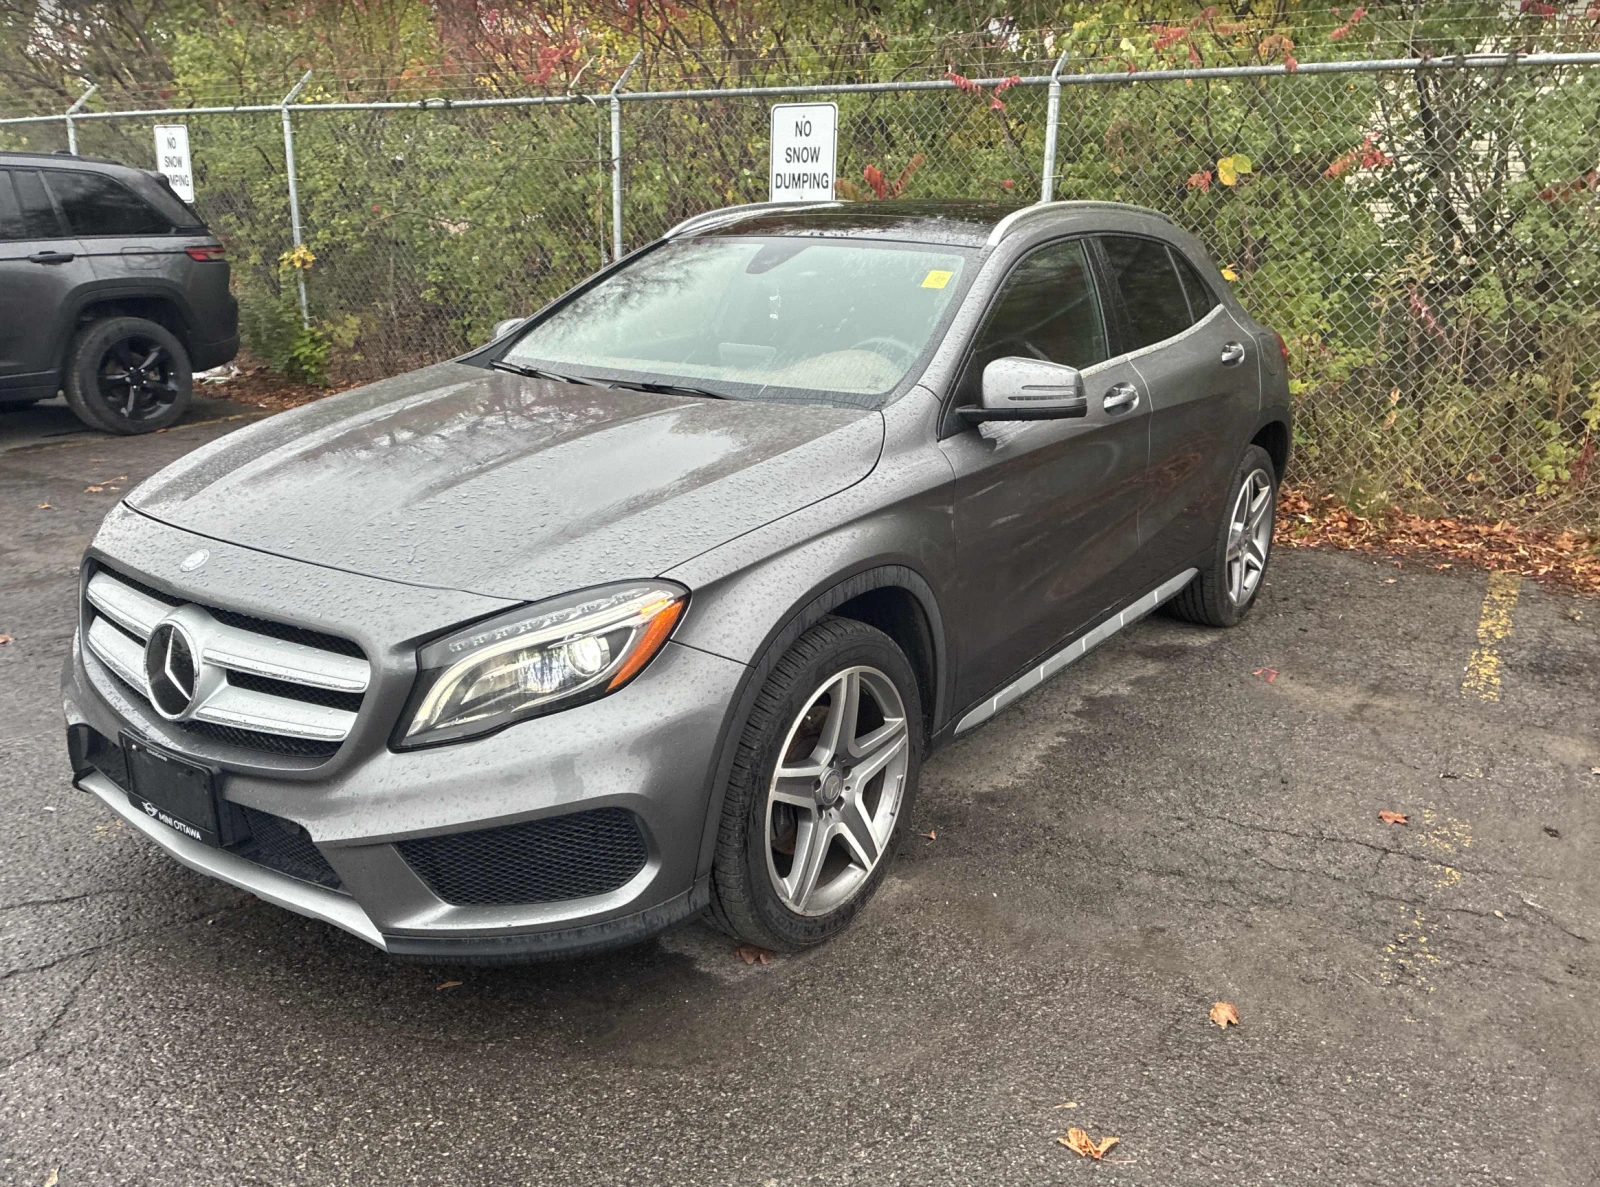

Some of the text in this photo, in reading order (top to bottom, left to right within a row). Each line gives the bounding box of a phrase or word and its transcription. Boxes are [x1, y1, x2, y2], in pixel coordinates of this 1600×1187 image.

[794, 120, 812, 137] NO
[167, 137, 176, 149] NO
[164, 156, 183, 168] SNOW
[785, 146, 821, 163] SNOW
[168, 174, 190, 187] MPING
[775, 172, 829, 190] DUMPING
[158, 811, 202, 841] MINI OTTAWA
